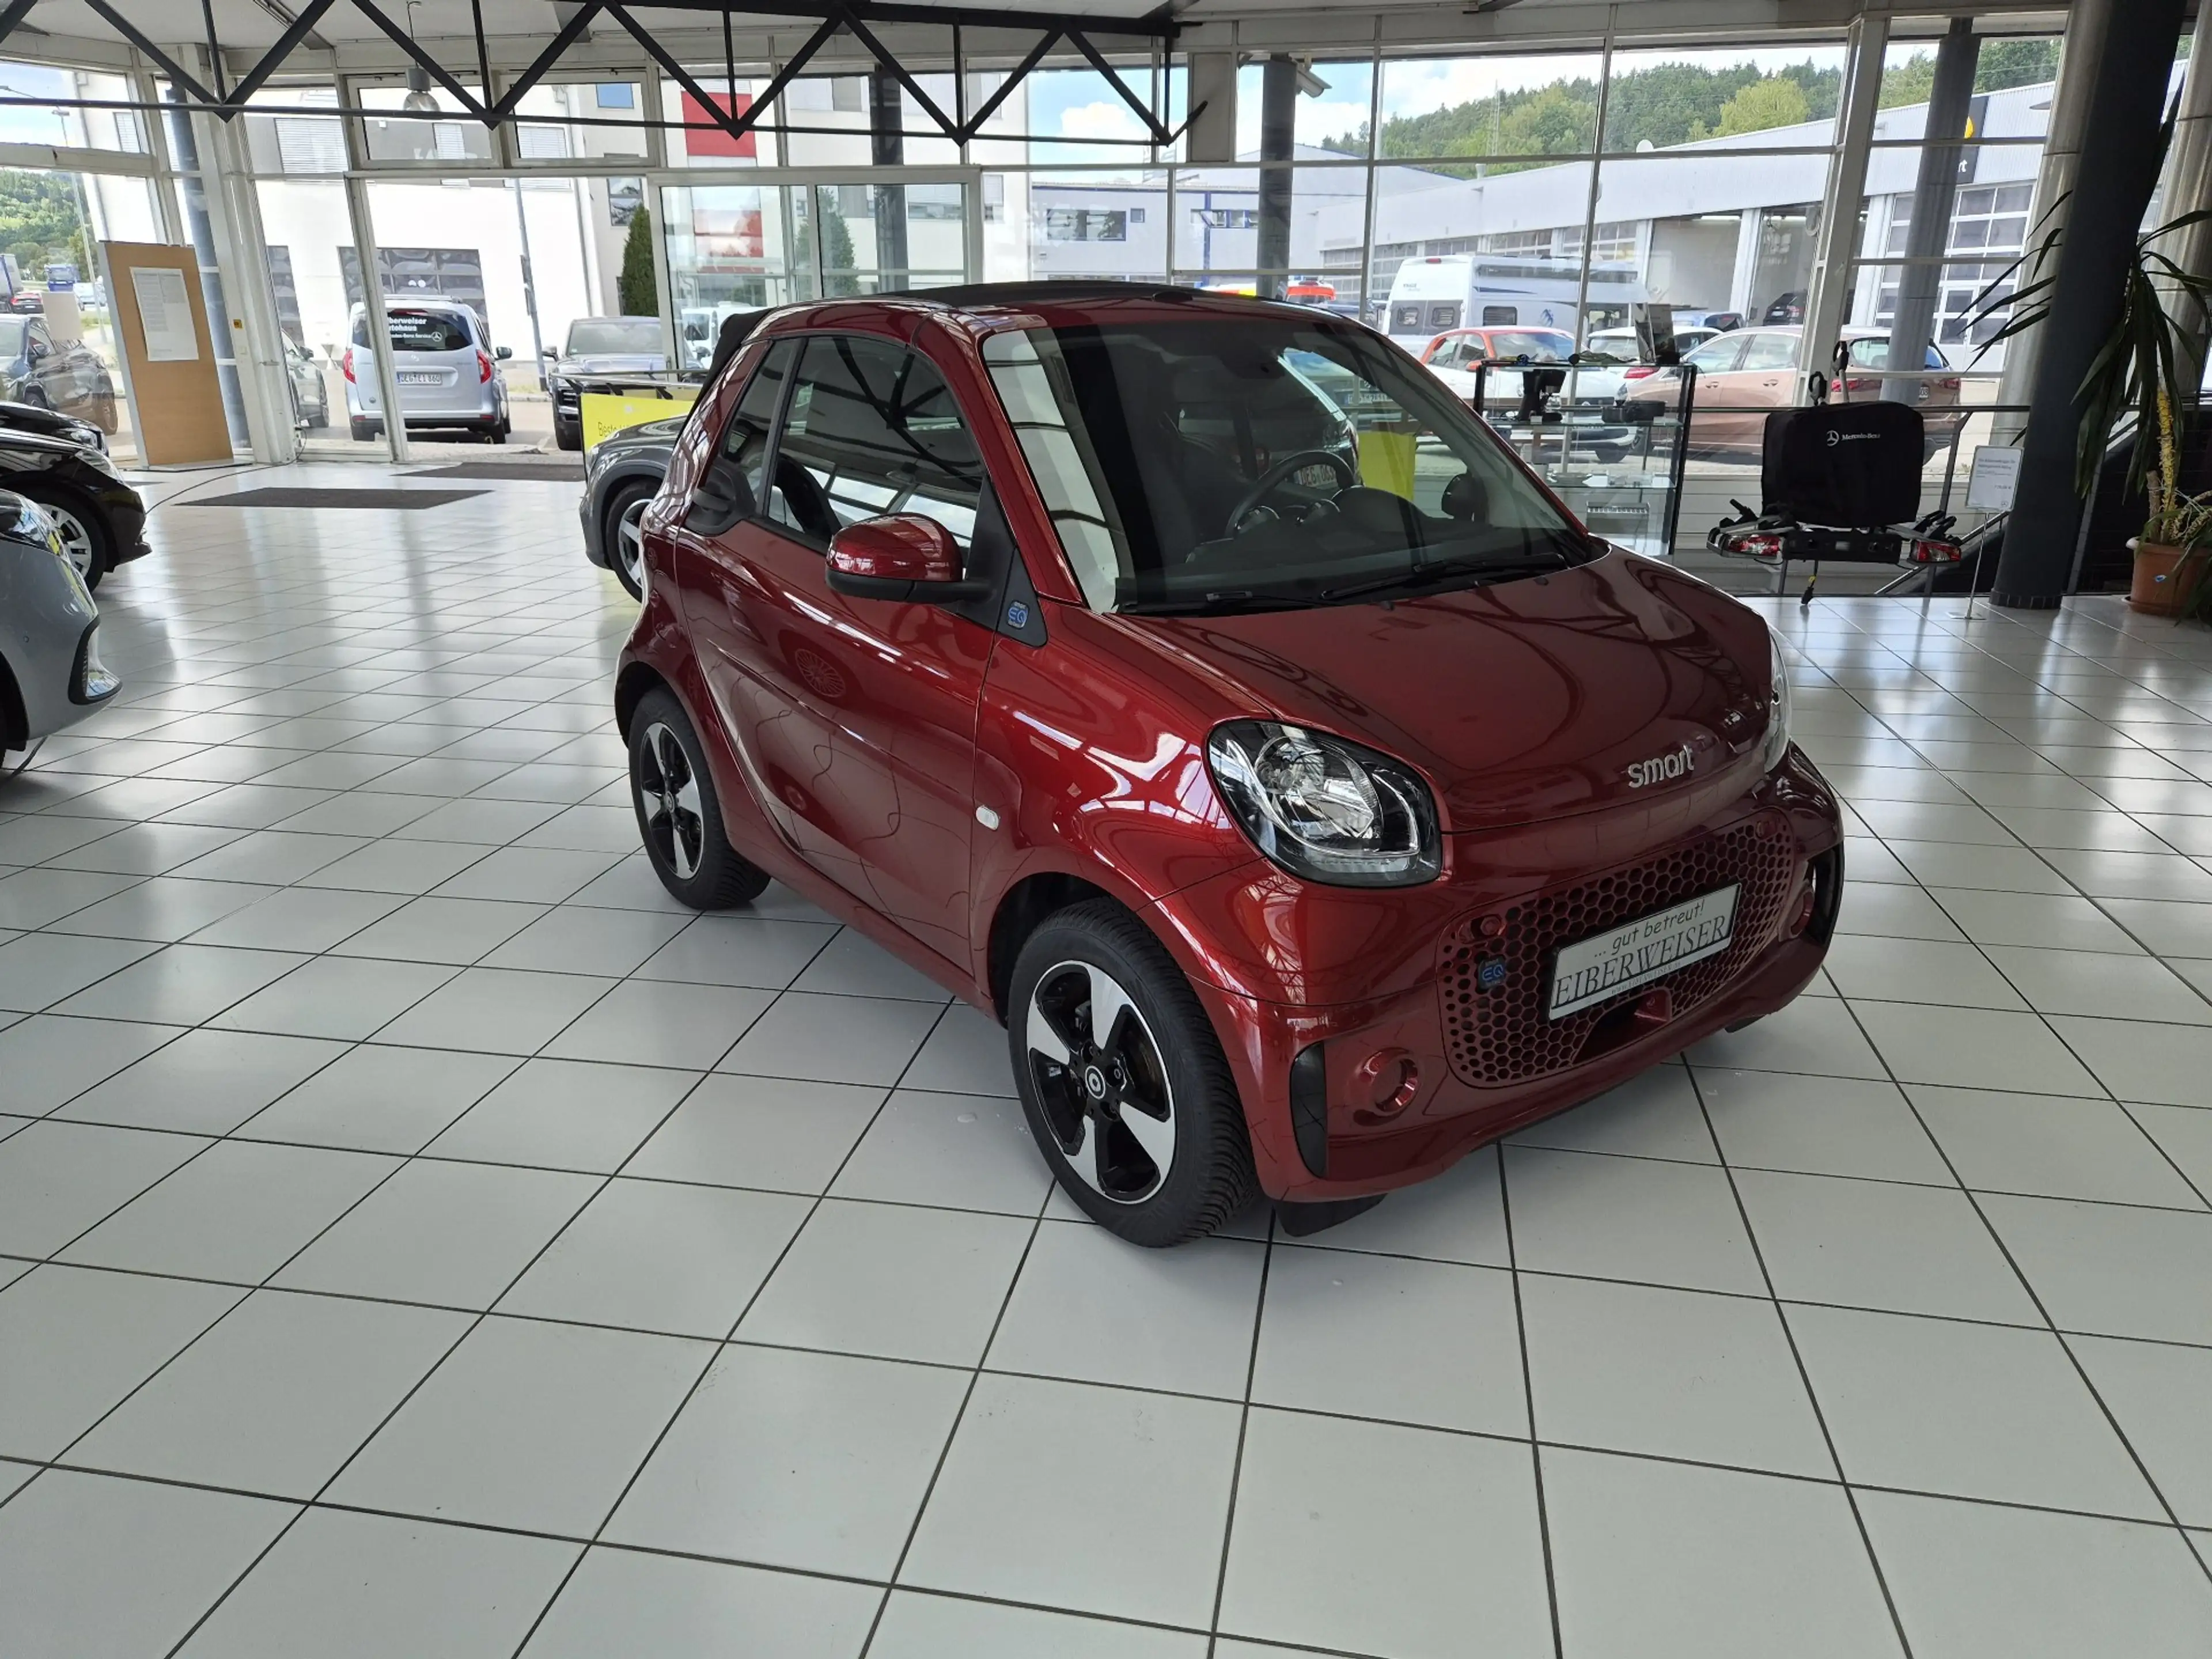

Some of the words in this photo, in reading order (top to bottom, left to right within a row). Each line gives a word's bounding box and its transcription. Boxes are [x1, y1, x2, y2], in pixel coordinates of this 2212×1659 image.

[1628, 744, 1694, 788] smart
[1613, 929, 1639, 955] gut
[1644, 899, 1705, 938] betreut!
[1555, 915, 1726, 1007] EIBERWEISER
